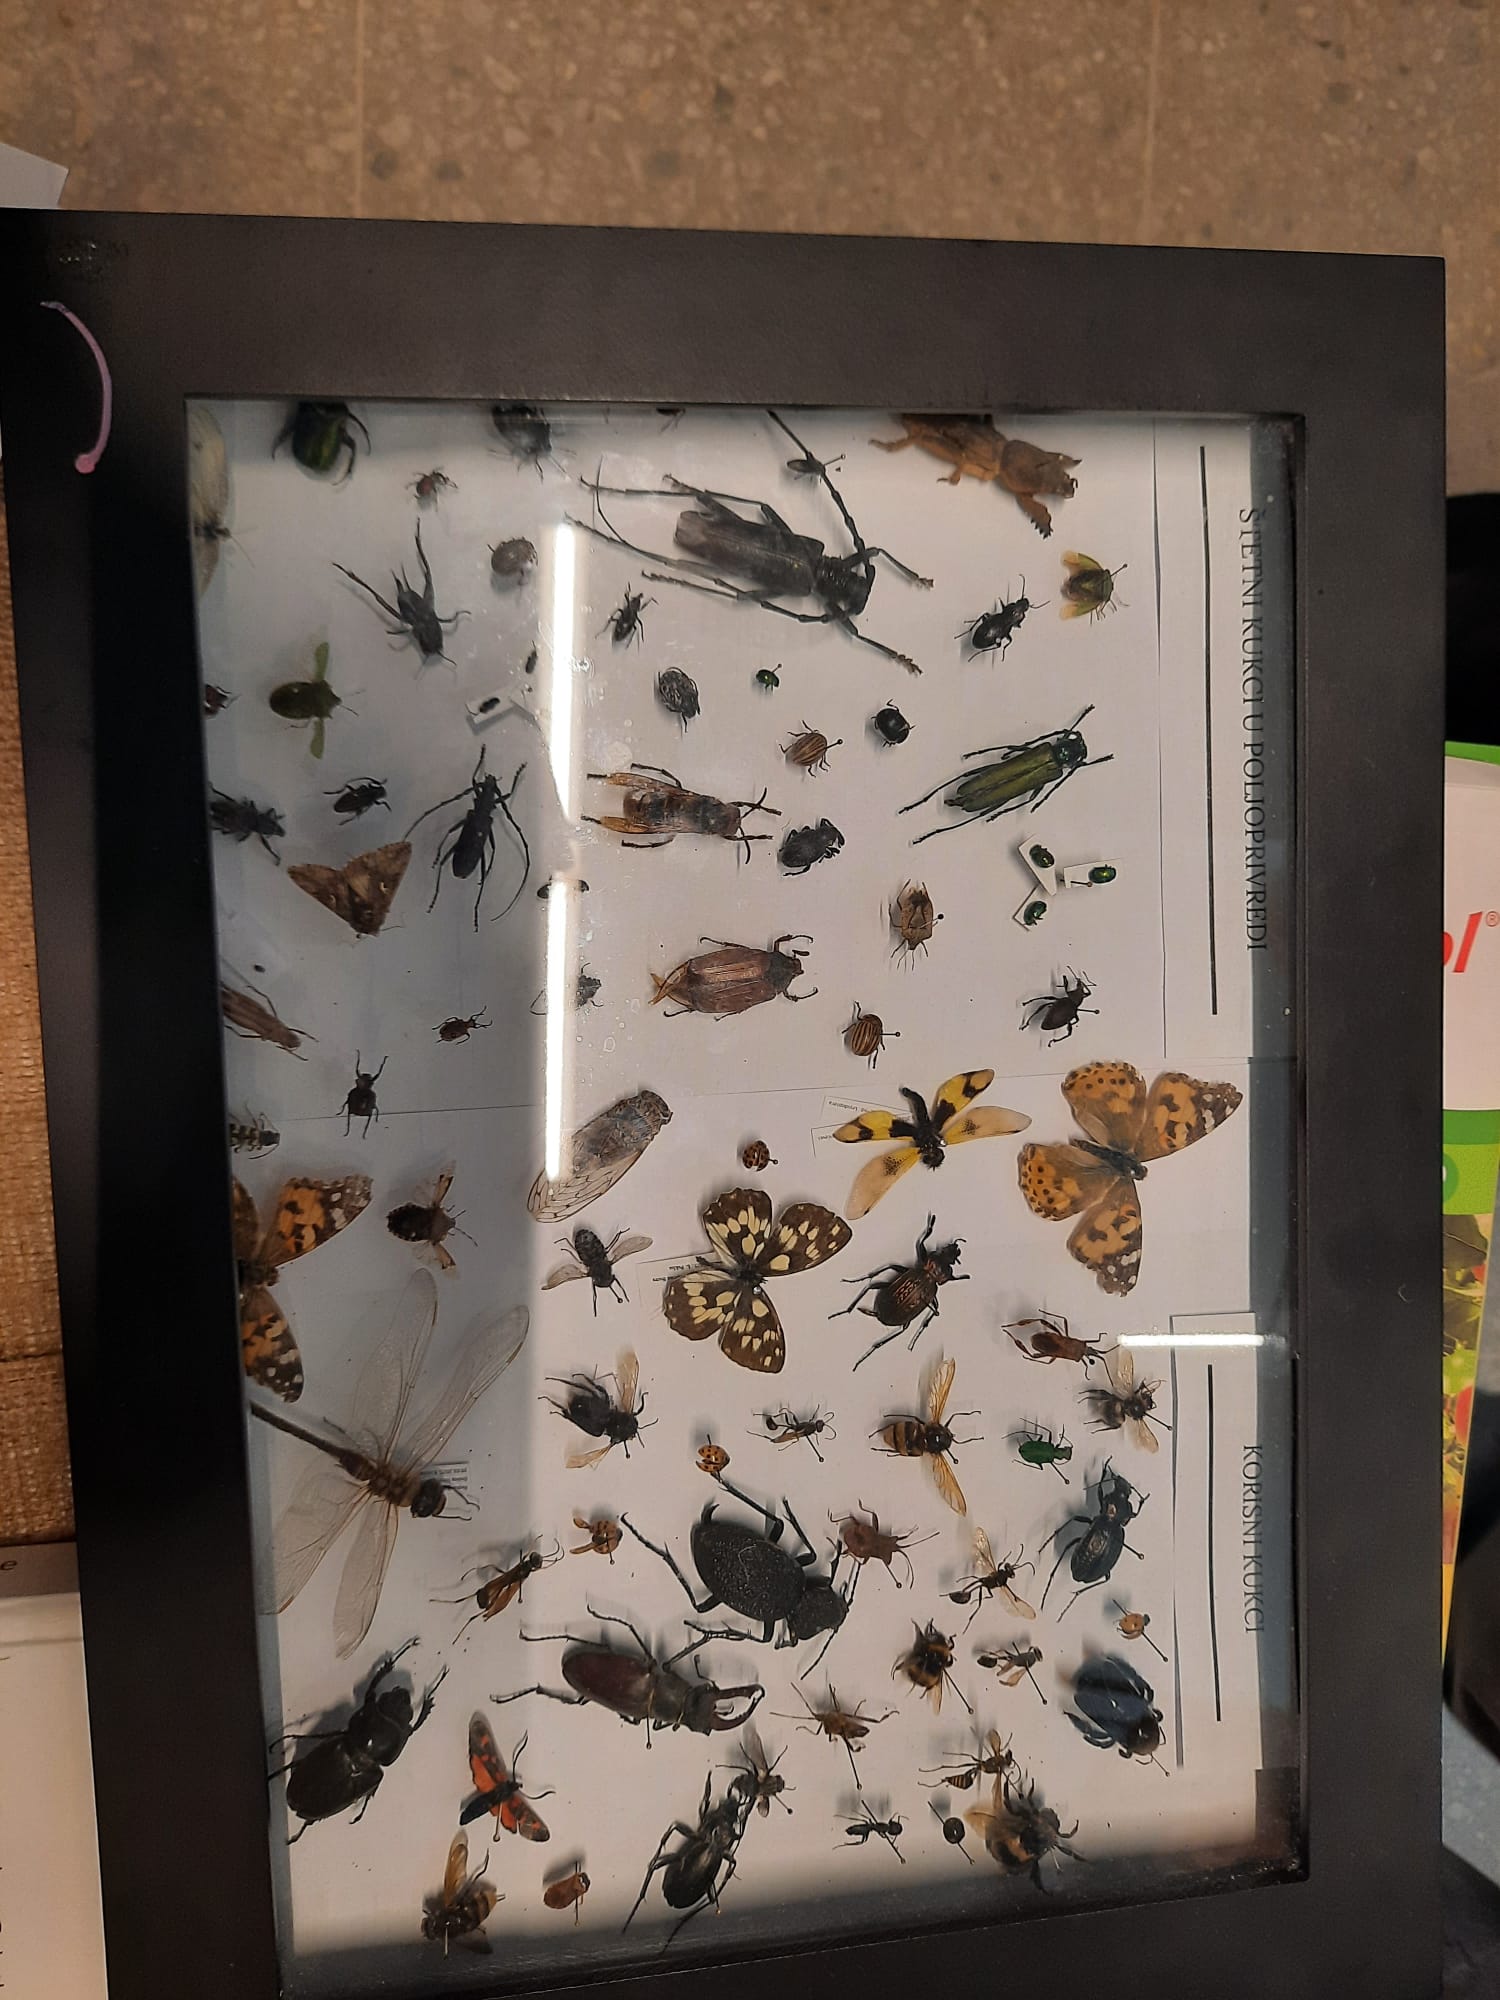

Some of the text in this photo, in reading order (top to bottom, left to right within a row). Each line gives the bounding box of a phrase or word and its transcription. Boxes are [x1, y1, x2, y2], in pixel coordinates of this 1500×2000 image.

[1239, 508, 1267, 950] ŠTETNI KUKCI U POLJOPRIVREDI
[1242, 1446, 1265, 1633] KORISNI KUKCI
